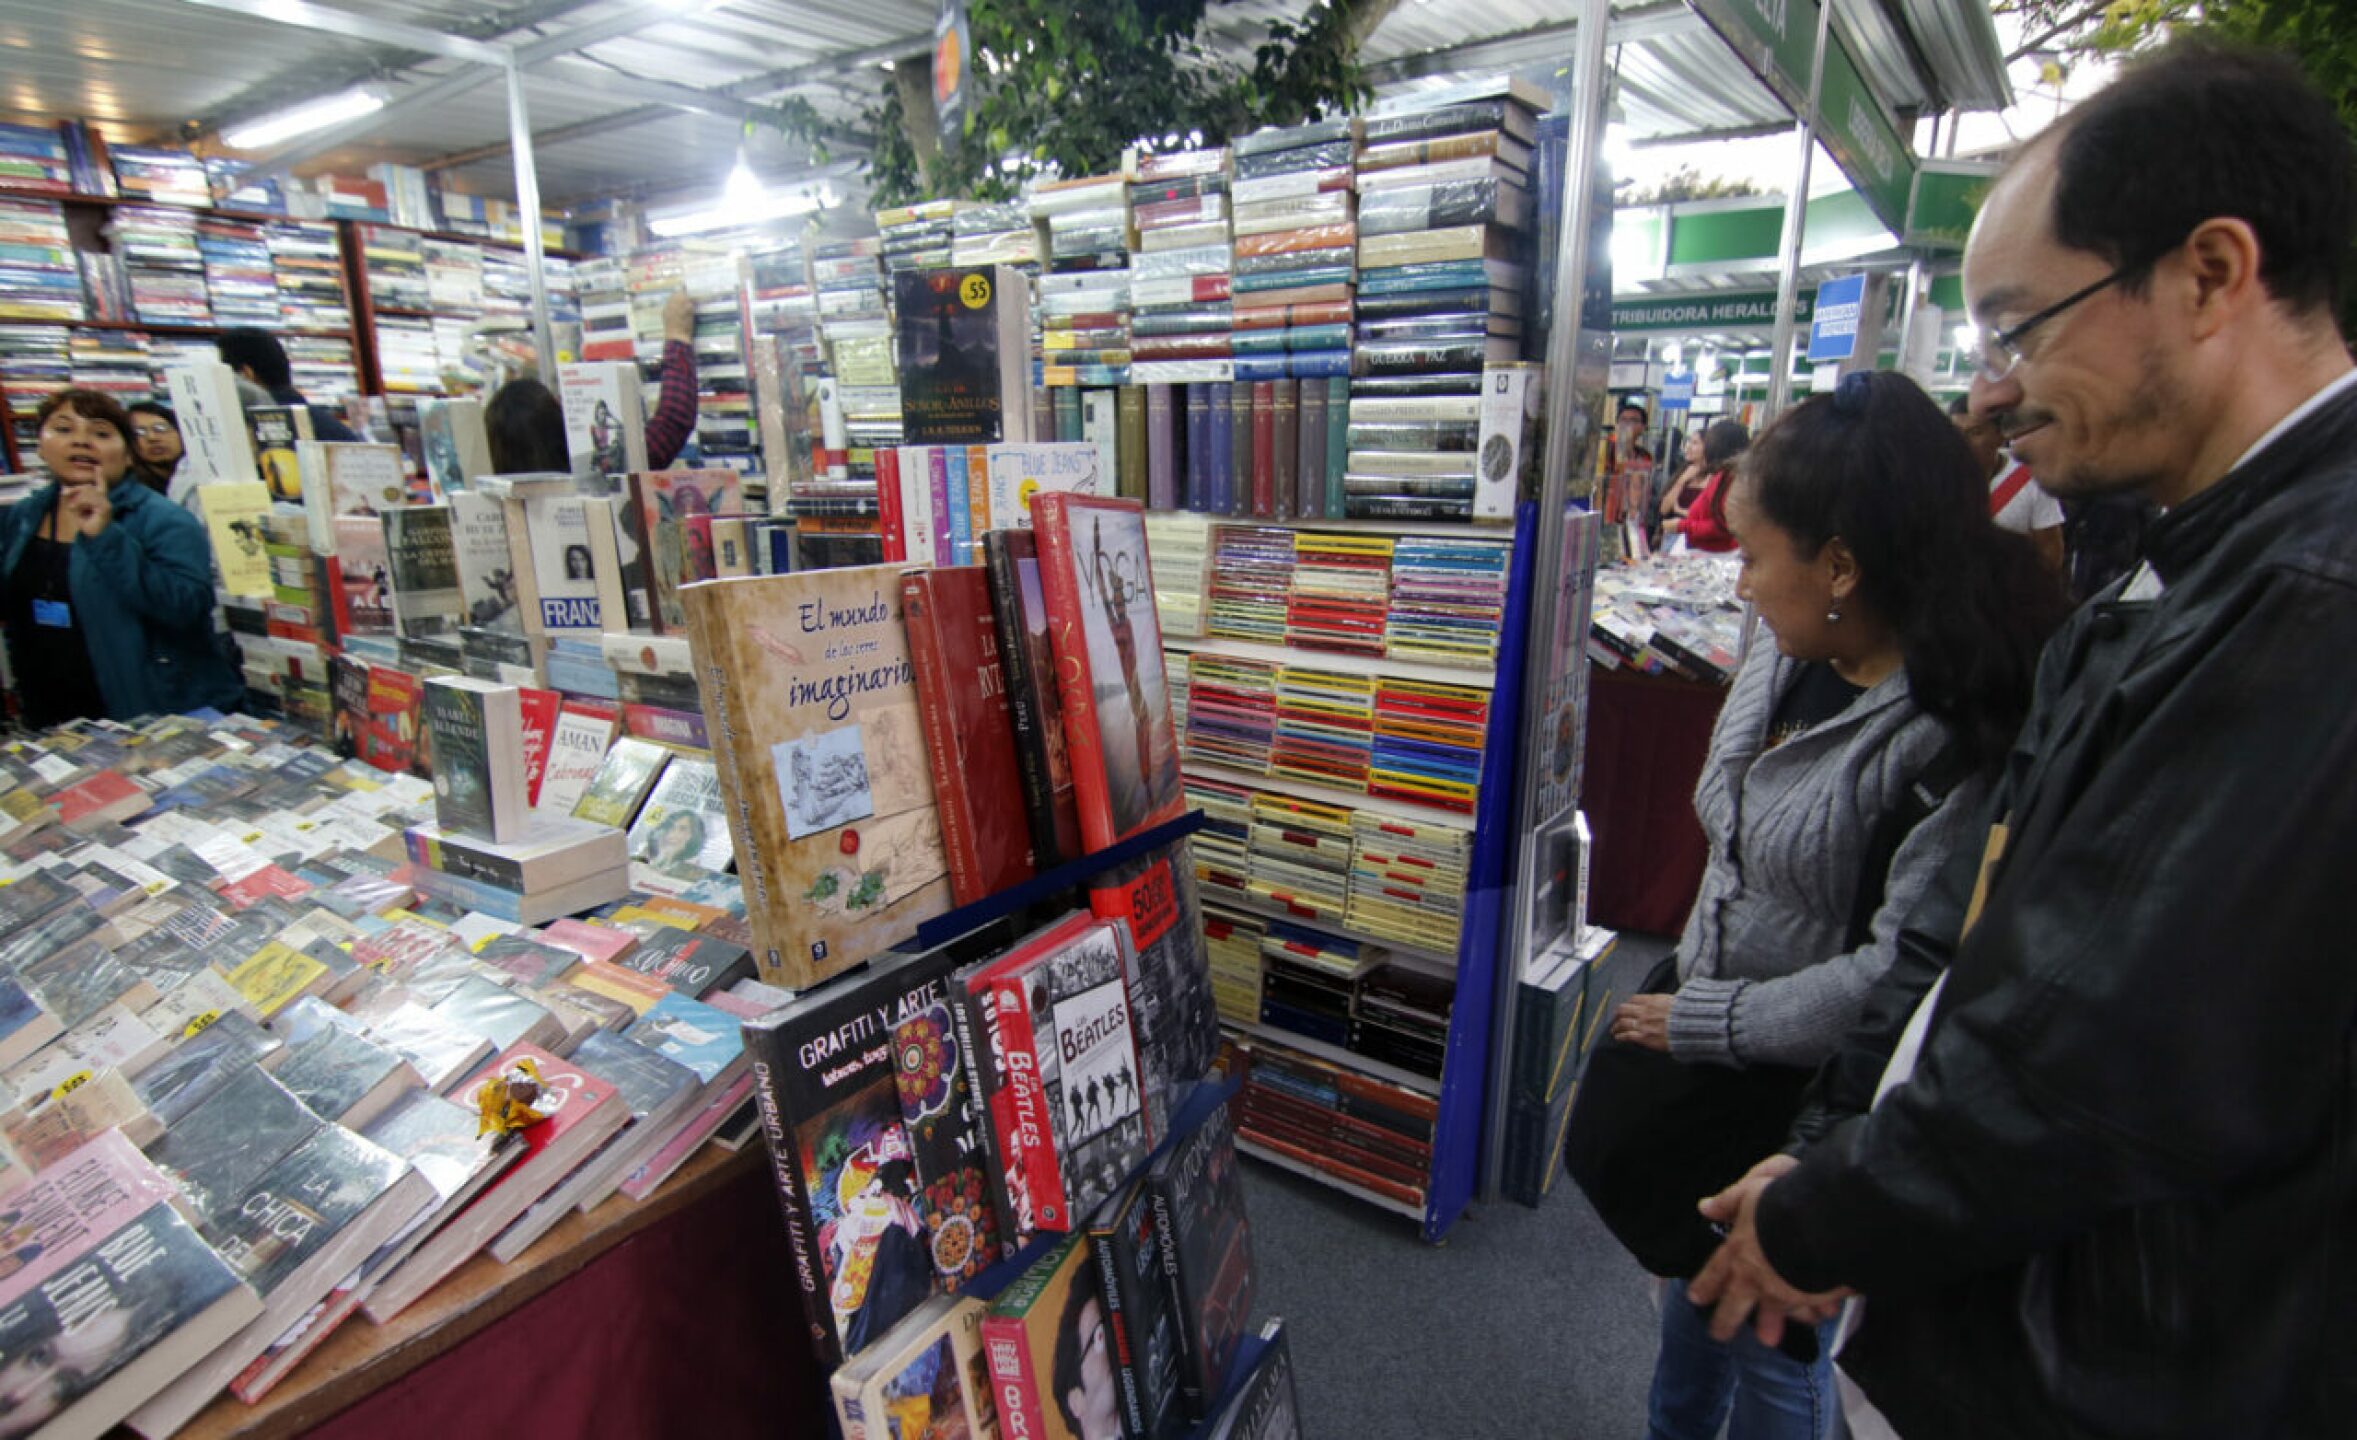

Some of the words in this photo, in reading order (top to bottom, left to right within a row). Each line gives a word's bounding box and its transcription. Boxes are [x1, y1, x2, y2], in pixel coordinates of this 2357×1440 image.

[1711, 301, 1808, 319] HERALDS
[1022, 456, 1046, 476] BLUE
[1052, 453, 1082, 474] JEANS
[1076, 550, 1149, 609] YOGA
[798, 597, 826, 632] El
[829, 590, 888, 628] mundo
[1054, 620, 1091, 747] YOGA
[799, 1013, 874, 1069] GRAFITI
[877, 1004, 890, 1030] Y
[898, 979, 940, 1022] ARTE
[1060, 1003, 1126, 1066] BEATLES
[754, 1061, 784, 1140] URBANO
[1007, 1051, 1041, 1149] BEATLES
[767, 1146, 795, 1198] ARTE
[241, 1191, 314, 1248] CHICA
[790, 1220, 816, 1293] GRAFITI
